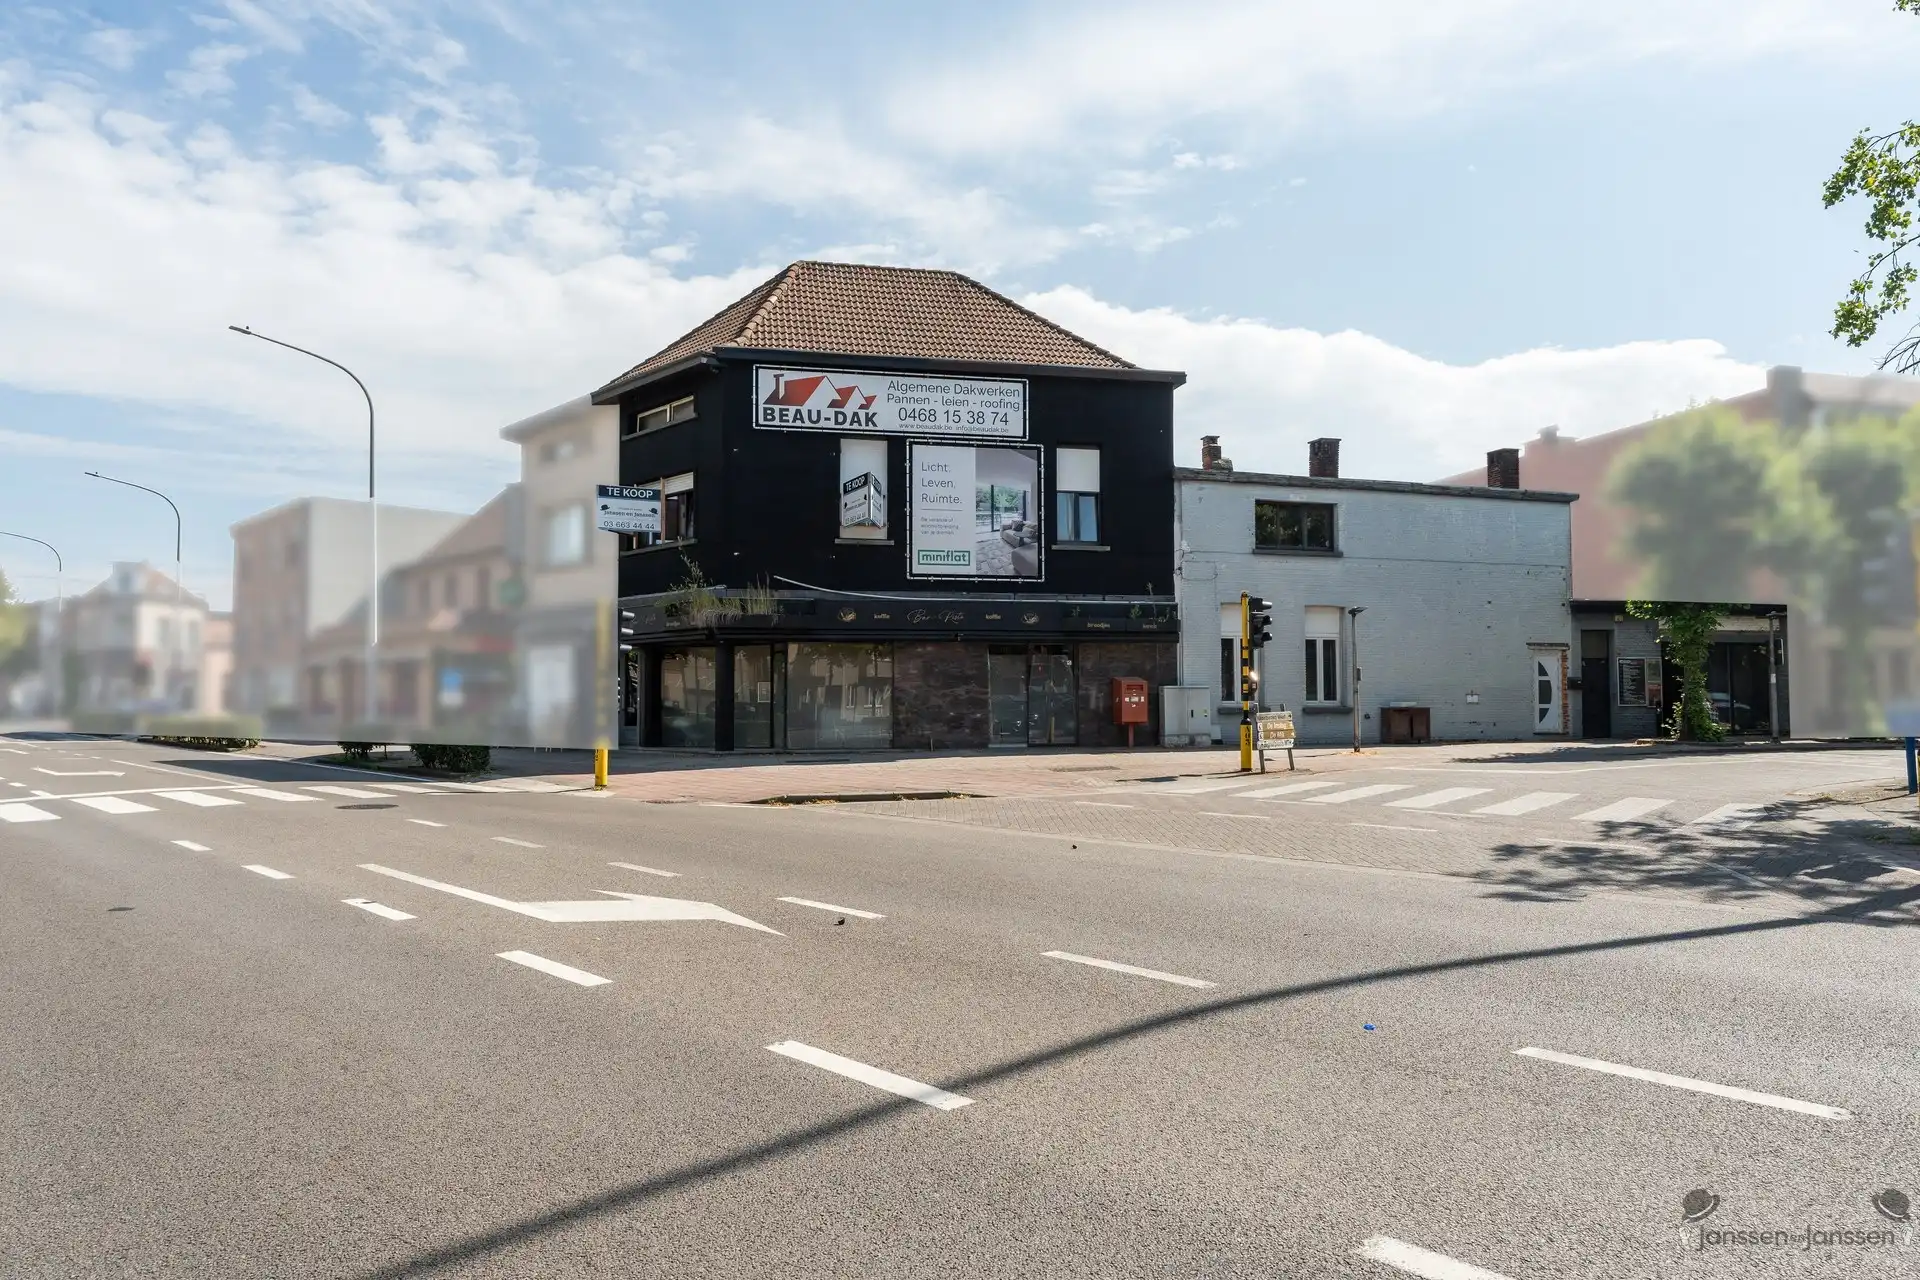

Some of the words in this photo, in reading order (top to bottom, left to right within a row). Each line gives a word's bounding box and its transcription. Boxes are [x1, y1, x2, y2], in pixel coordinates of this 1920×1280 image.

[887, 380, 951, 394] Algemene
[953, 383, 1020, 397] Dakwerken
[887, 393, 930, 405] Pannen
[941, 396, 969, 407] leien
[980, 398, 1020, 412] roofing
[762, 406, 878, 427] BEAU-DAK
[898, 407, 937, 422] 0468
[943, 409, 962, 423] 15
[966, 410, 985, 425] 38
[990, 411, 1009, 426] 74
[846, 482, 852, 492] TE
[852, 475, 865, 488] KOOP
[606, 487, 620, 496] TE
[623, 488, 653, 498] KOOP
[921, 493, 963, 504] Ruimte.
[921, 550, 967, 562] miniflat
